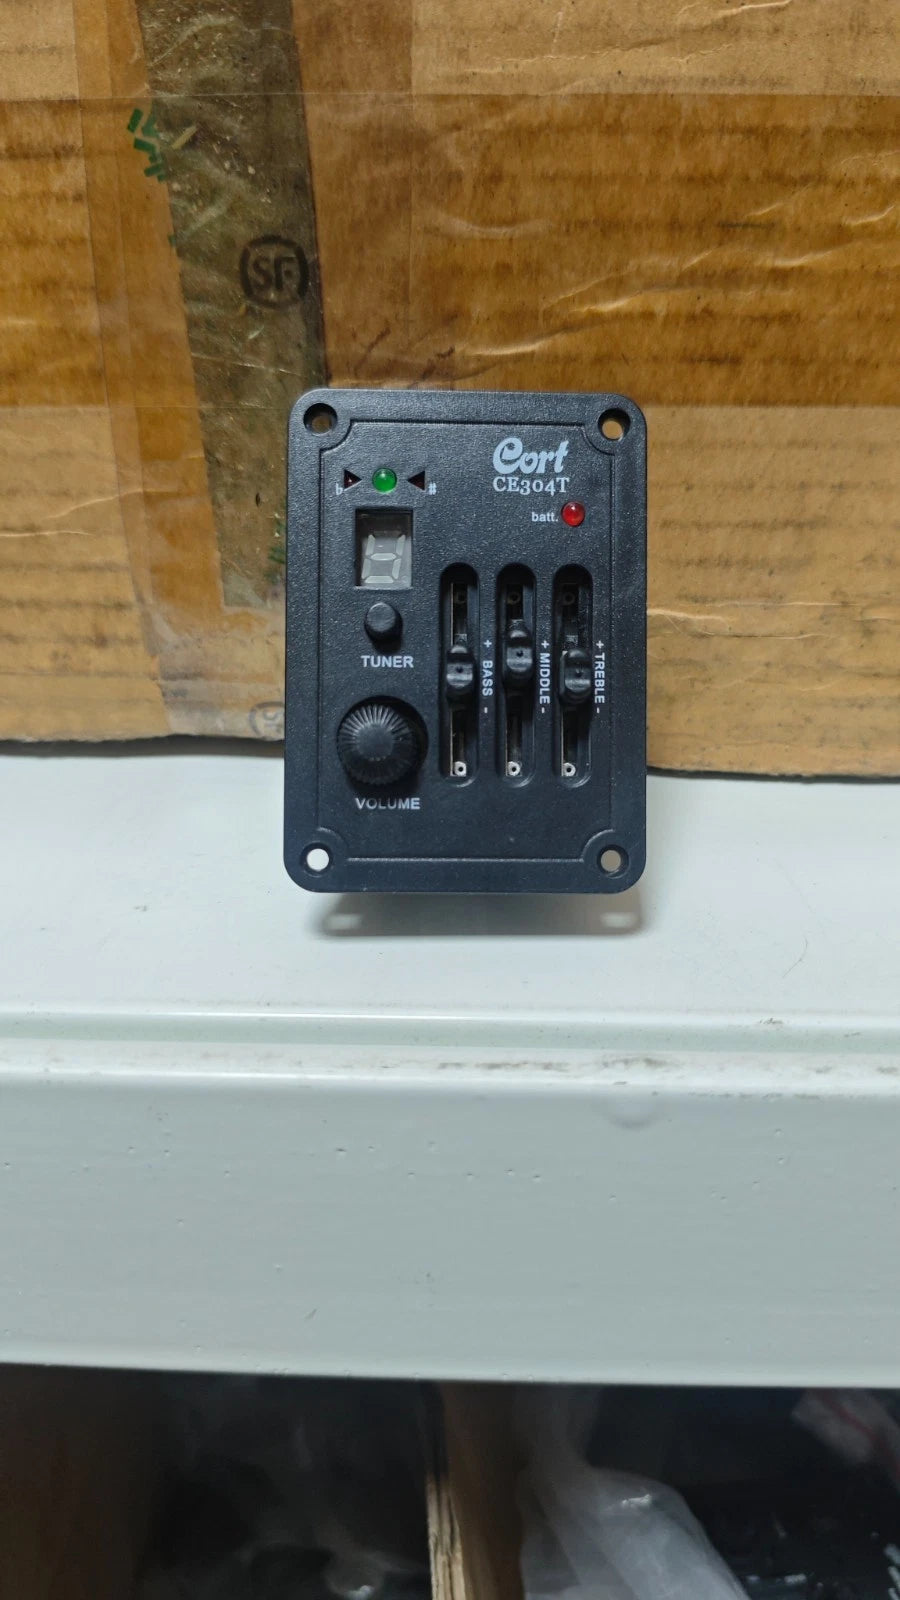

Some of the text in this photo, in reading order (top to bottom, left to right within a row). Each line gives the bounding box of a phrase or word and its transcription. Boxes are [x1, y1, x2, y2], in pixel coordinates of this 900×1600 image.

[252, 256, 297, 292] SF
[492, 437, 569, 474] Cort
[493, 477, 570, 496] CE304T
[531, 512, 559, 523] batt.
[361, 655, 414, 668] TUNER
[481, 660, 493, 697] BASS
[539, 652, 550, 705] MIDDLE
[594, 652, 605, 704] TREBLE
[355, 797, 420, 810] VOLUME
